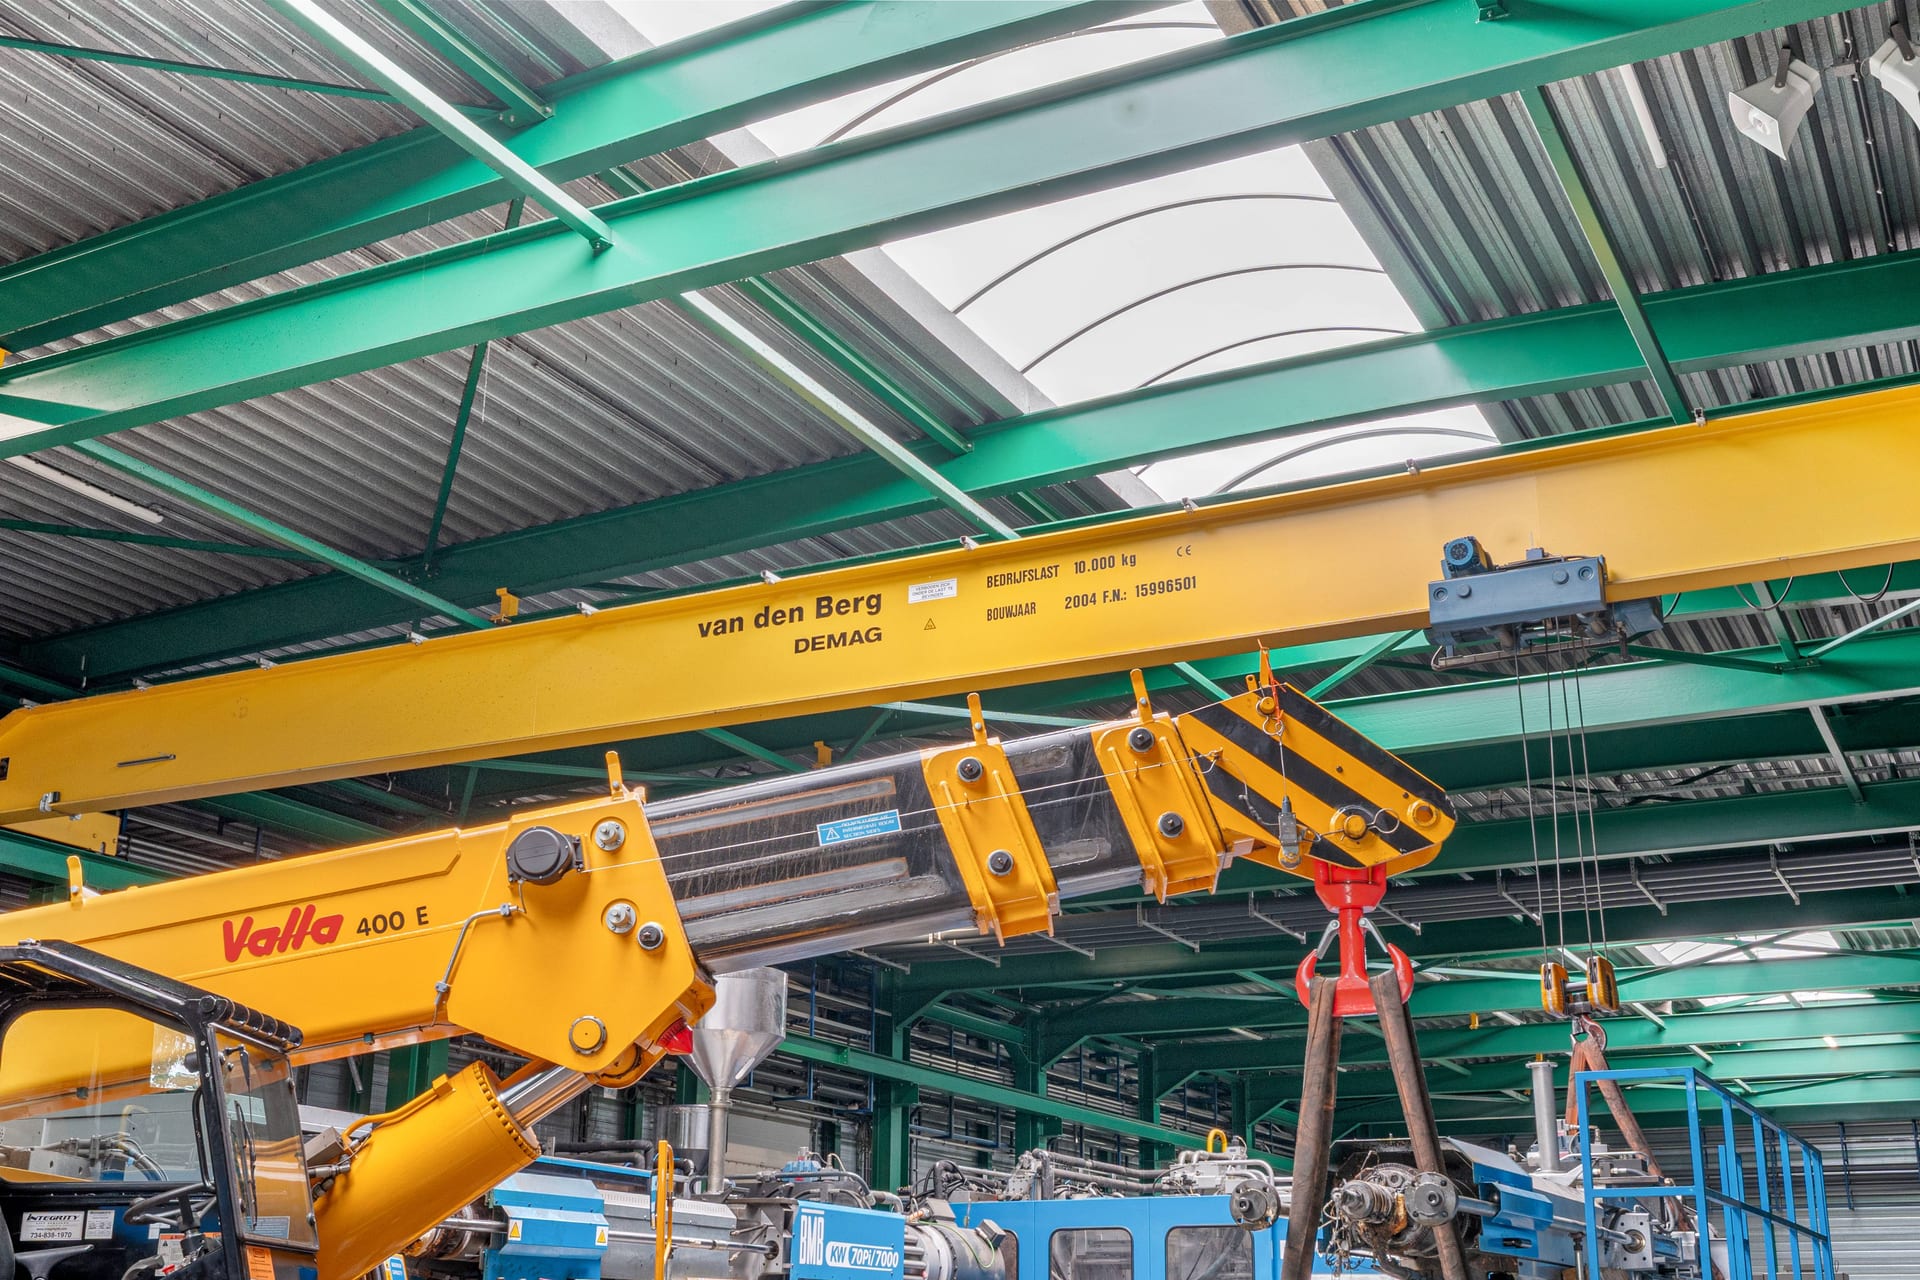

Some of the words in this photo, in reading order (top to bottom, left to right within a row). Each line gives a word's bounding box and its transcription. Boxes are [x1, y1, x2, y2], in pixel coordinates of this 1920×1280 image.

[986, 564, 1060, 589] BEDRIJFSLAST
[1074, 555, 1115, 575] 10.000
[1121, 553, 1137, 567] kg
[697, 615, 744, 638] van
[754, 605, 804, 629] den
[815, 593, 882, 620] Berg
[986, 601, 1036, 622] BOUWJAAR
[1065, 592, 1097, 610] 2004
[1102, 588, 1127, 604] F.N.:
[1135, 575, 1197, 598] 15996501
[794, 626, 882, 654] DEMAG
[222, 903, 344, 963] Valla
[356, 910, 405, 937] 400
[416, 905, 430, 926] E
[26, 1213, 80, 1221] INTEGRITY
[799, 1214, 825, 1266] BMB
[830, 1245, 847, 1264] KW
[850, 1247, 899, 1269] 70Pi/7000
